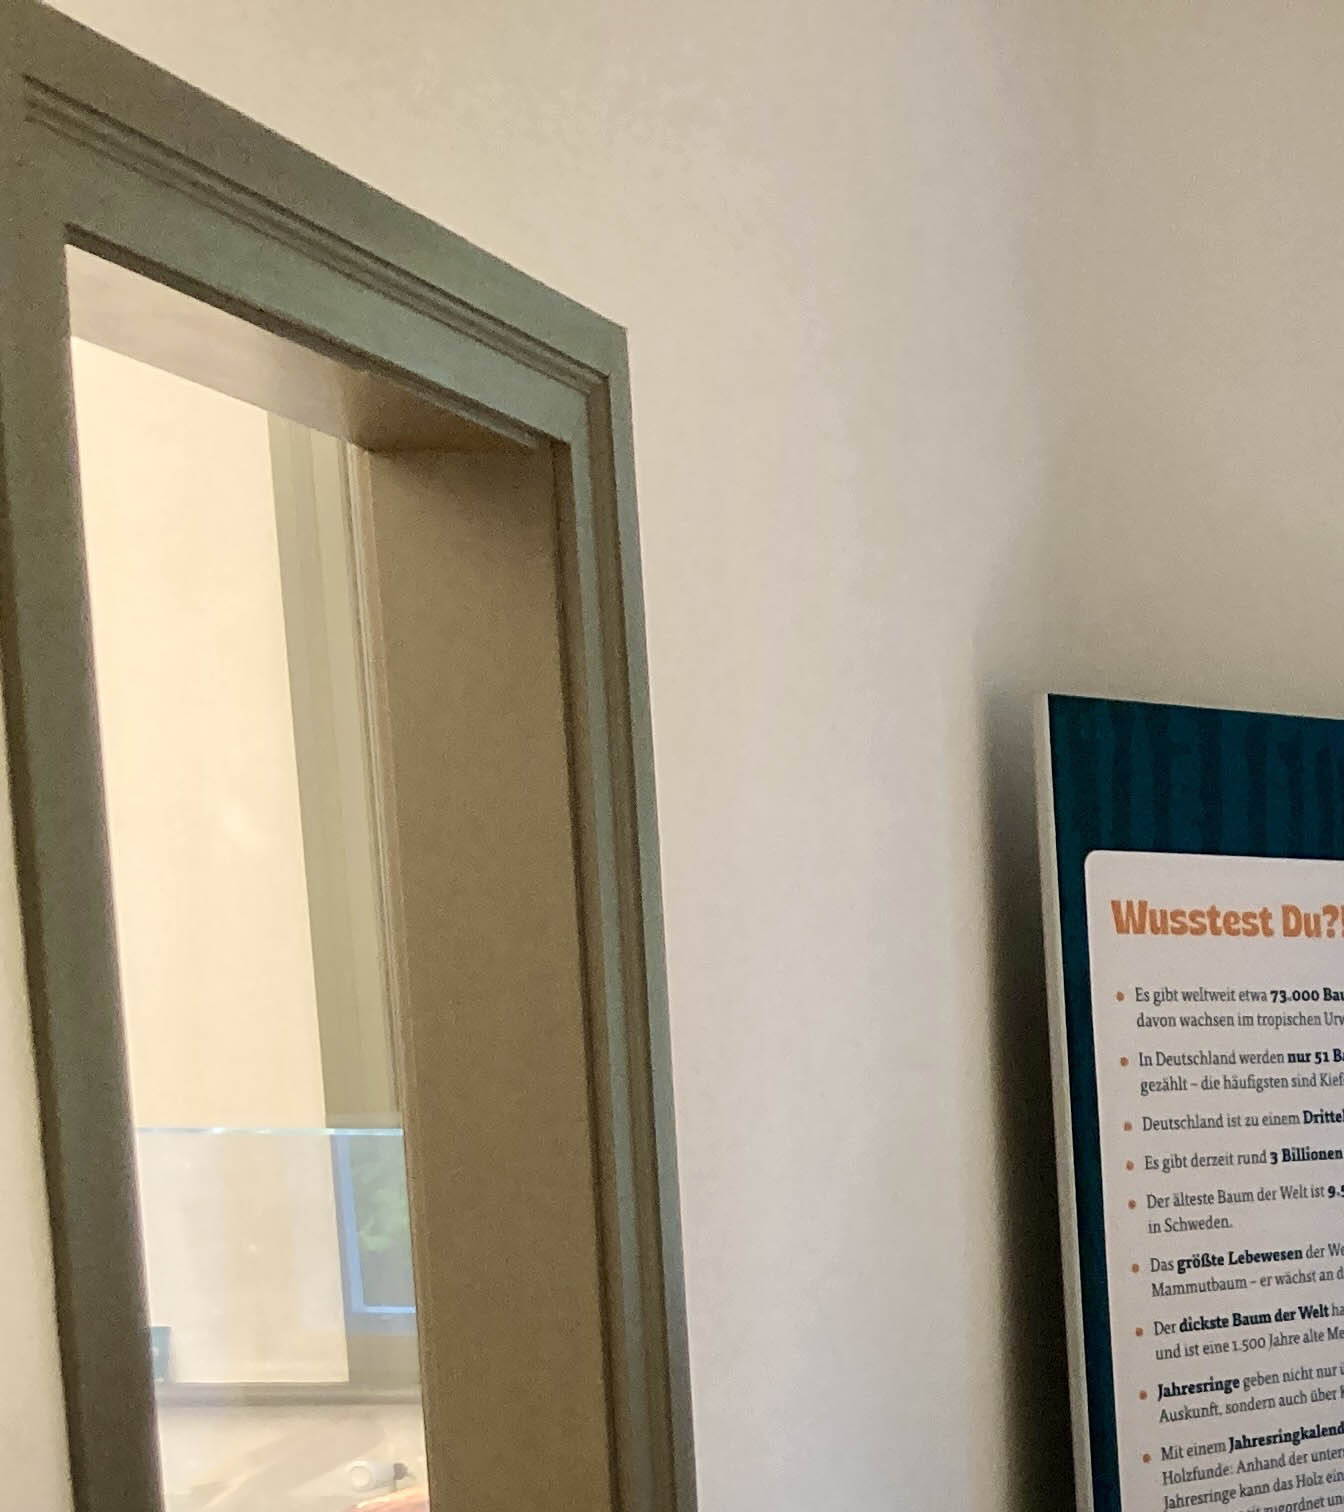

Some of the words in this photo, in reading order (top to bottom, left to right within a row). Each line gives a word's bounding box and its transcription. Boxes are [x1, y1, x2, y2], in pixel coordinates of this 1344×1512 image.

[1111, 900, 1274, 936] Wusstest
[1135, 987, 1149, 1001] Es
[1153, 988, 1178, 1006] gibt
[1182, 987, 1234, 1002] weltweit
[1238, 989, 1267, 1001] etwa
[1270, 990, 1319, 1002] 73.000
[1137, 1013, 1176, 1027] davon
[1180, 1013, 1234, 1027] wachsen
[1238, 1013, 1254, 1026] im
[1257, 1012, 1321, 1029] tropischen
[1139, 1052, 1152, 1066] In
[1156, 1051, 1236, 1066] Deutschland
[1240, 1052, 1284, 1064] werden
[1288, 1053, 1311, 1063] nur
[1315, 1052, 1329, 1064] 51
[1141, 1077, 1188, 1095] gezählt
[1201, 1076, 1220, 1089] die
[1224, 1075, 1288, 1092] häufigsten
[1292, 1074, 1317, 1088] sind
[1143, 1115, 1224, 1131] Deutschland
[1227, 1113, 1241, 1127] ist
[1245, 1116, 1259, 1127] zu
[1263, 1114, 1300, 1126] einem
[1145, 1155, 1159, 1170] Es
[1162, 1154, 1187, 1173] gibt
[1191, 1152, 1233, 1167] derzeit
[1237, 1150, 1267, 1165] rund
[1270, 1154, 1278, 1164] 3
[1282, 1146, 1343, 1162] Billionen
[1147, 1194, 1169, 1208] Der
[1173, 1192, 1214, 1207] älteste
[1218, 1190, 1253, 1204] Baum
[1257, 1188, 1276, 1201] der
[1280, 1184, 1307, 1200] Welt
[1311, 1184, 1325, 1198] ist
[1148, 1222, 1161, 1234] in
[1165, 1215, 1232, 1233] Schweden.
[1151, 1257, 1174, 1272] Das
[1177, 1253, 1224, 1274] größte
[1229, 1250, 1302, 1265] Lebewesen
[1306, 1244, 1325, 1259] der
[1152, 1277, 1247, 1297] Mammutbaum
[1260, 1277, 1272, 1287] er
[1275, 1270, 1316, 1285] wächst
[1319, 1268, 1333, 1281] an
[1154, 1322, 1176, 1336] Der
[1179, 1316, 1229, 1333] dickste
[1233, 1312, 1271, 1326] Baum
[1274, 1308, 1296, 1323] der
[1299, 1304, 1329, 1318] Welt
[1155, 1344, 1181, 1360] und
[1185, 1343, 1199, 1357] ist
[1203, 1342, 1229, 1355] eine
[1269, 1333, 1300, 1350] Jahre
[1303, 1328, 1325, 1343] alte
[1157, 1376, 1240, 1401] Jahresringe
[1243, 1372, 1280, 1391] geben
[1283, 1368, 1313, 1383] nicht
[1317, 1368, 1337, 1378] nur
[1160, 1402, 1223, 1423] Auskunft,
[1225, 1396, 1276, 1414] sondern
[1279, 1392, 1307, 1407] auch
[1310, 1389, 1337, 1402] über
[1161, 1446, 1182, 1461] Mit
[1187, 1442, 1227, 1457] einem
[1162, 1466, 1233, 1486] Holzfunde:
[1237, 1457, 1286, 1473] Anhand
[1289, 1453, 1308, 1465] der
[1163, 1489, 1237, 1512] Jahresringe
[1240, 1484, 1270, 1497] kann
[1273, 1479, 1293, 1492] das
[1296, 1472, 1323, 1489] Holz
